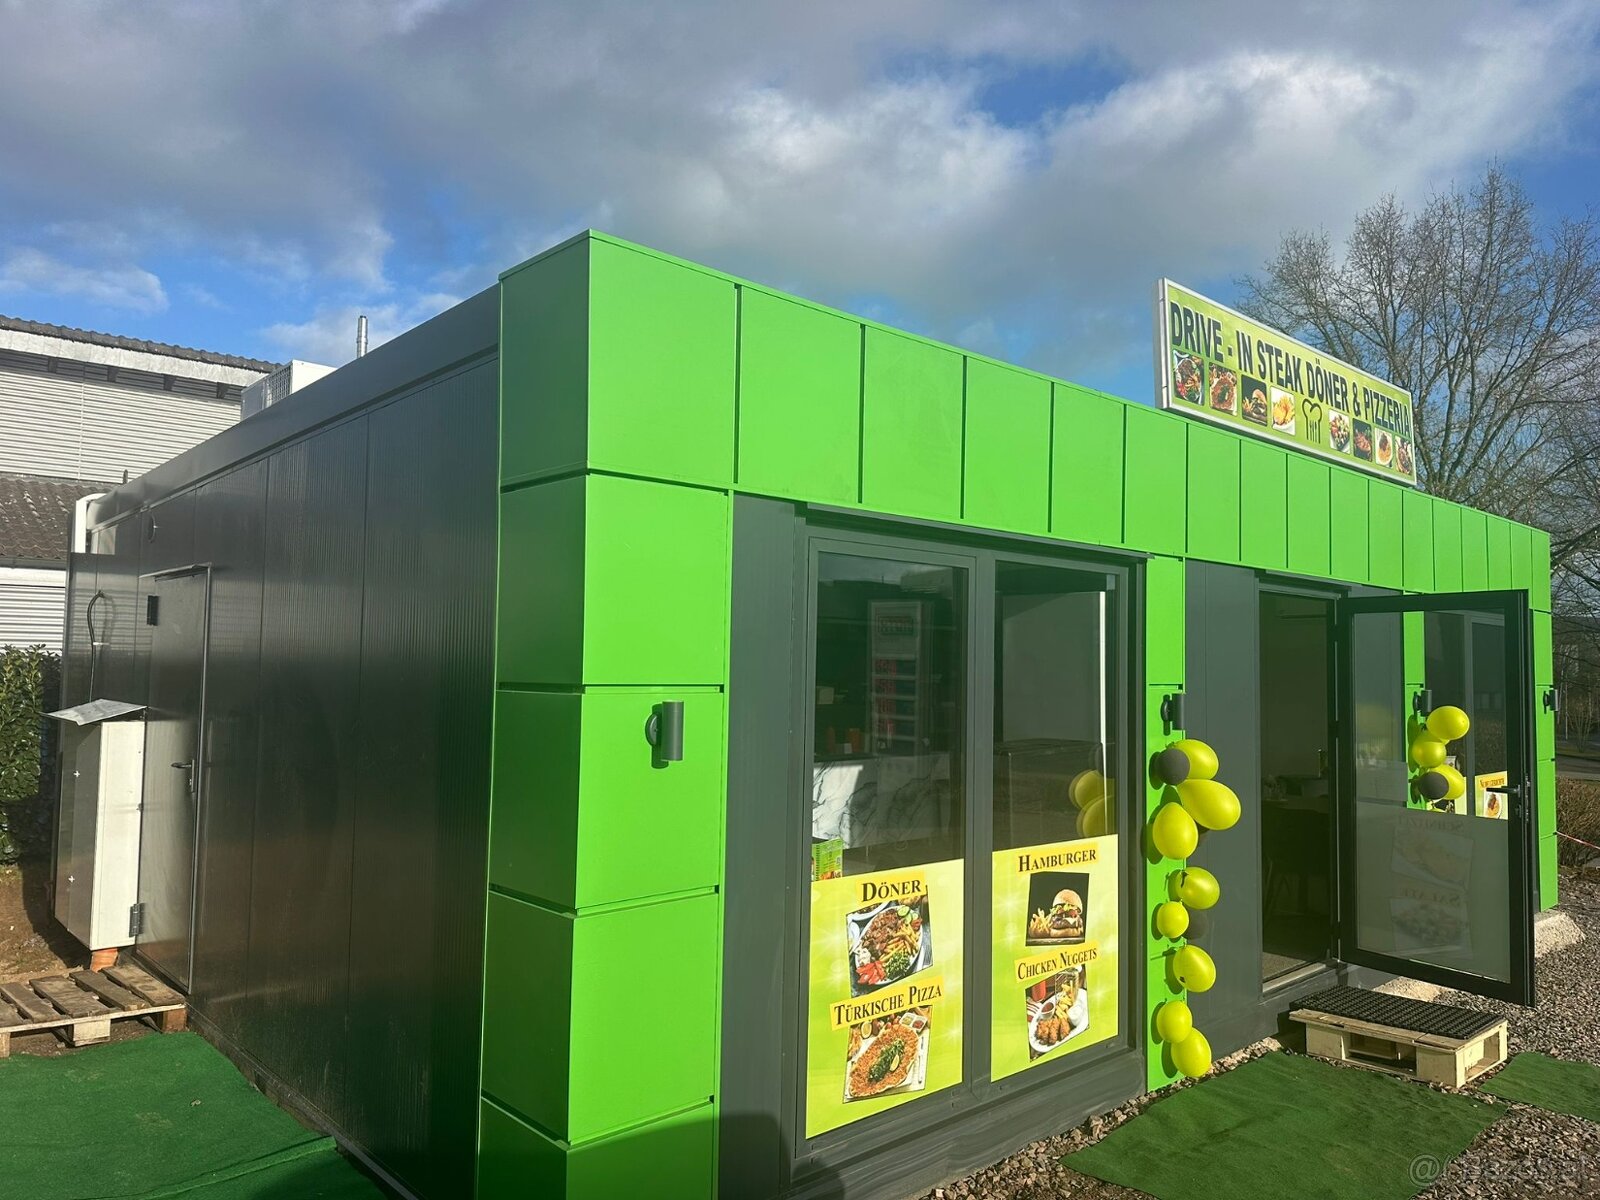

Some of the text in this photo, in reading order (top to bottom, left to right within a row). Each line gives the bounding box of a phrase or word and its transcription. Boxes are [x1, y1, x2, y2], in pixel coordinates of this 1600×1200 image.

[1170, 301, 1224, 363] DRIVE
[1236, 329, 1254, 375] IN
[1256, 339, 1304, 394] STEAK
[1306, 358, 1350, 413] DÖNER
[1352, 382, 1361, 417] &
[1363, 387, 1412, 437] PIZZERIA
[1018, 849, 1097, 872] HAMBURGER
[861, 879, 921, 902] DÖNER
[1017, 947, 1098, 980] CHICKEN NUGGETS
[834, 983, 943, 1026] TÜRKISCHE PIZZA
